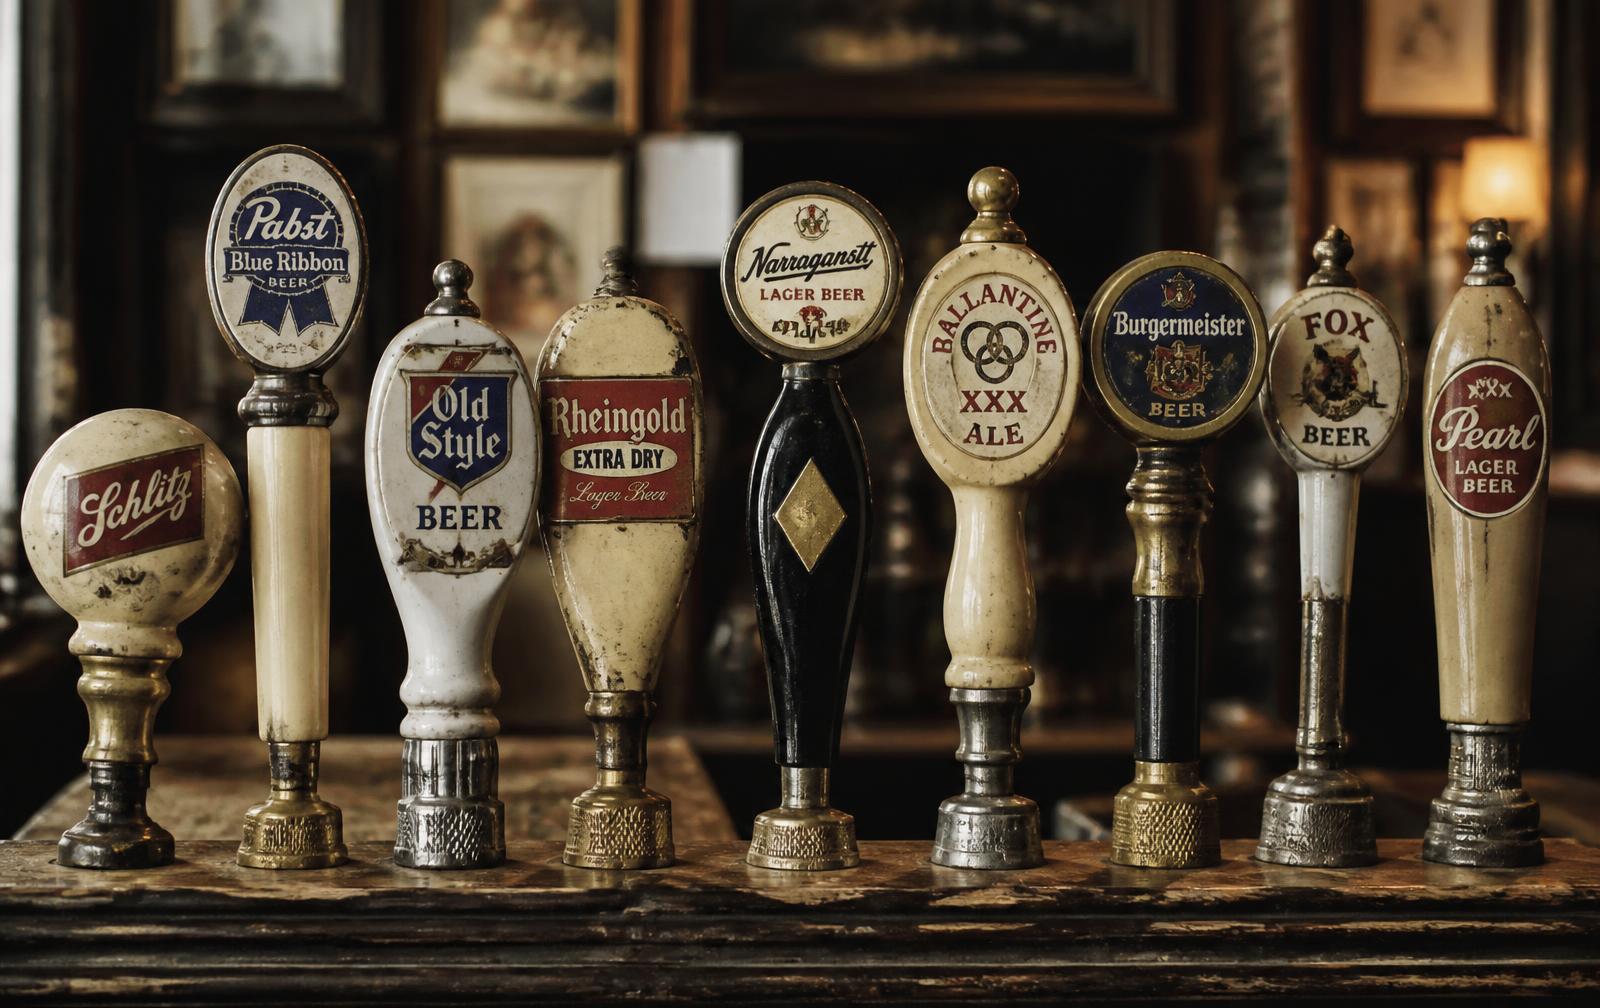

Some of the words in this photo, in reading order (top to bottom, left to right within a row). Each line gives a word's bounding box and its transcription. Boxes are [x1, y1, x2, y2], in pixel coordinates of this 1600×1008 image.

[245, 196, 336, 241] Pabst
[229, 251, 273, 271] Blue
[276, 251, 345, 272] Ribbon
[268, 277, 308, 288] BEER
[760, 288, 815, 301] LAGER
[821, 288, 865, 301] BEER
[932, 283, 1057, 354] BALLANTINE
[1113, 311, 1246, 341] Burgermeister
[1301, 309, 1375, 343] FOX
[432, 384, 491, 422] Old
[960, 390, 1028, 413] XXX
[1149, 402, 1206, 417] BEER
[549, 396, 687, 442] Rheingold
[1435, 404, 1541, 452] Pearl
[418, 422, 501, 470] Style
[963, 422, 1024, 446] ALE
[1302, 424, 1371, 446] BEER
[573, 449, 625, 469] EXTRA
[631, 449, 664, 469] DRY
[1455, 459, 1519, 475] LAGER
[1463, 478, 1516, 494] BEER
[78, 466, 192, 547] Schlitz
[416, 505, 503, 530] BEER
